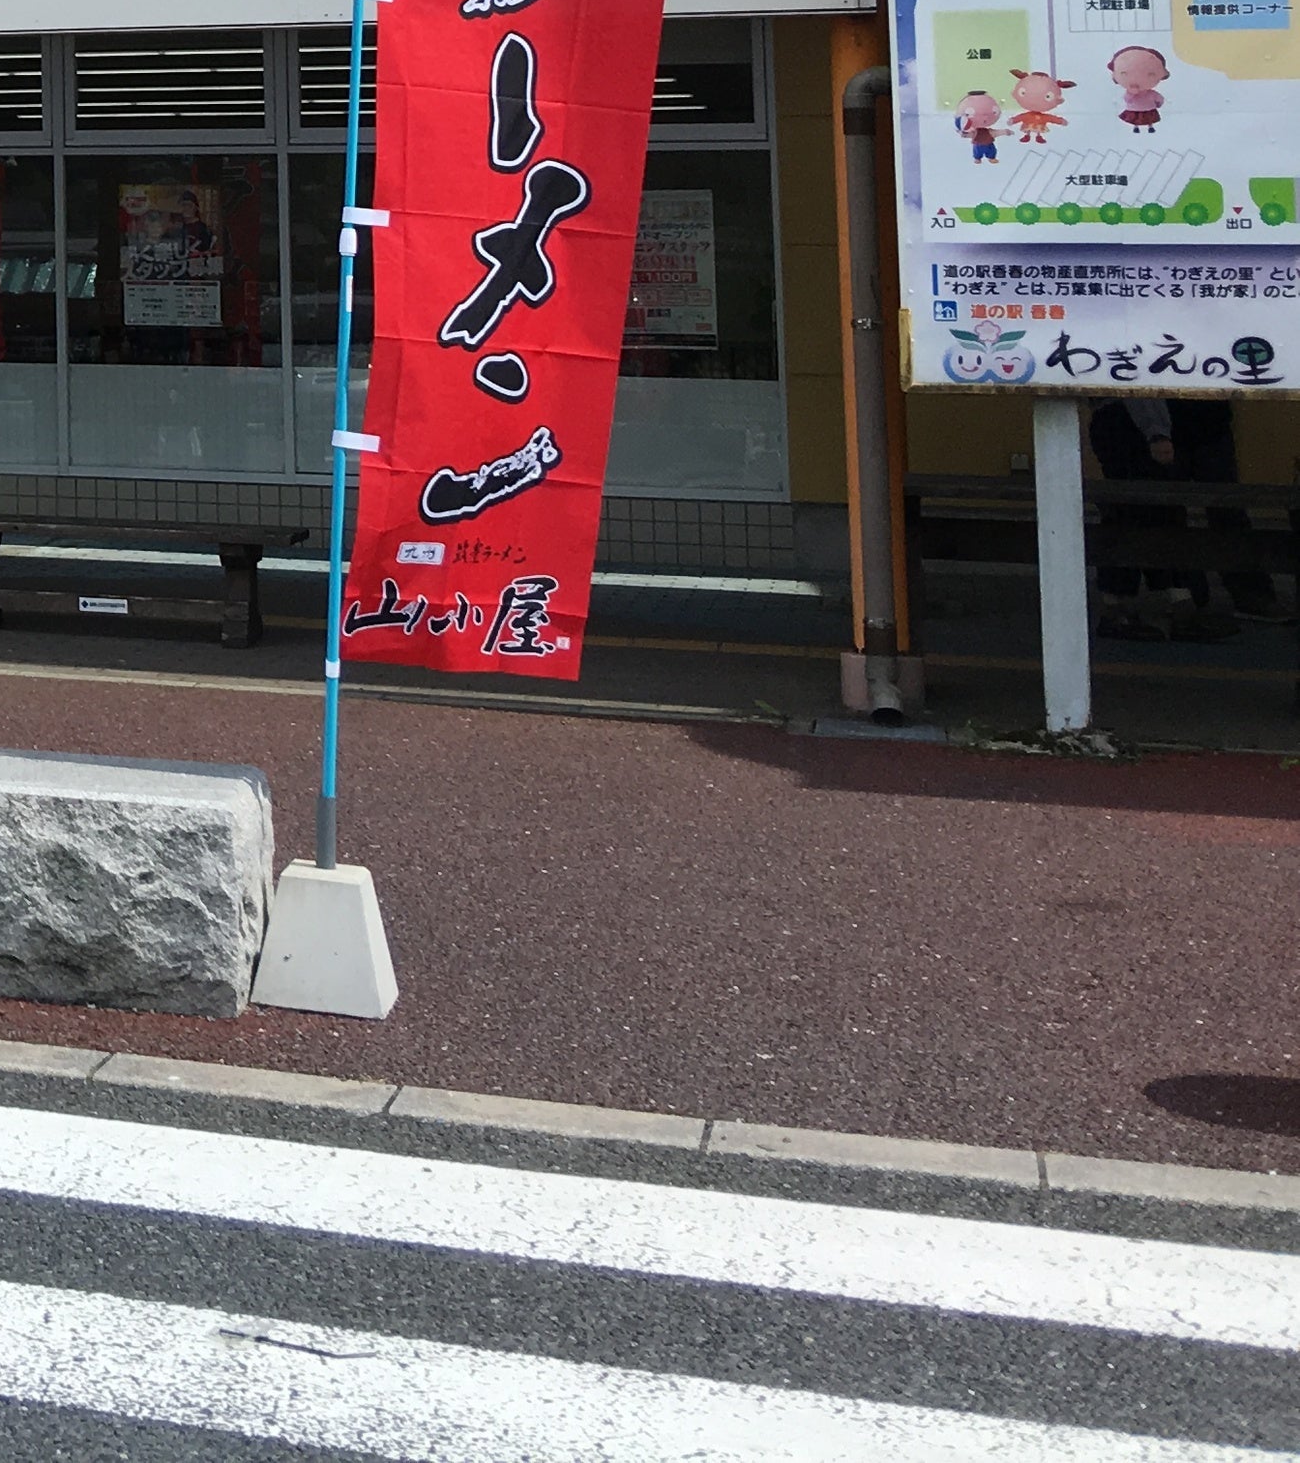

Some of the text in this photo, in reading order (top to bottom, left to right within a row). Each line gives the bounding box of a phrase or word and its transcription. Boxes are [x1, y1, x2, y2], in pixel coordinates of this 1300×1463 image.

[1186, 3, 1294, 17] 情報提供コーナー
[965, 47, 993, 61] 公園
[1064, 173, 1129, 187] 大型駐車場
[930, 217, 956, 229] 入口
[1225, 218, 1253, 230] 出口
[971, 304, 1024, 319] 道の駅
[1045, 330, 1284, 386] わぎえの里
[342, 575, 559, 657] 山小屋
